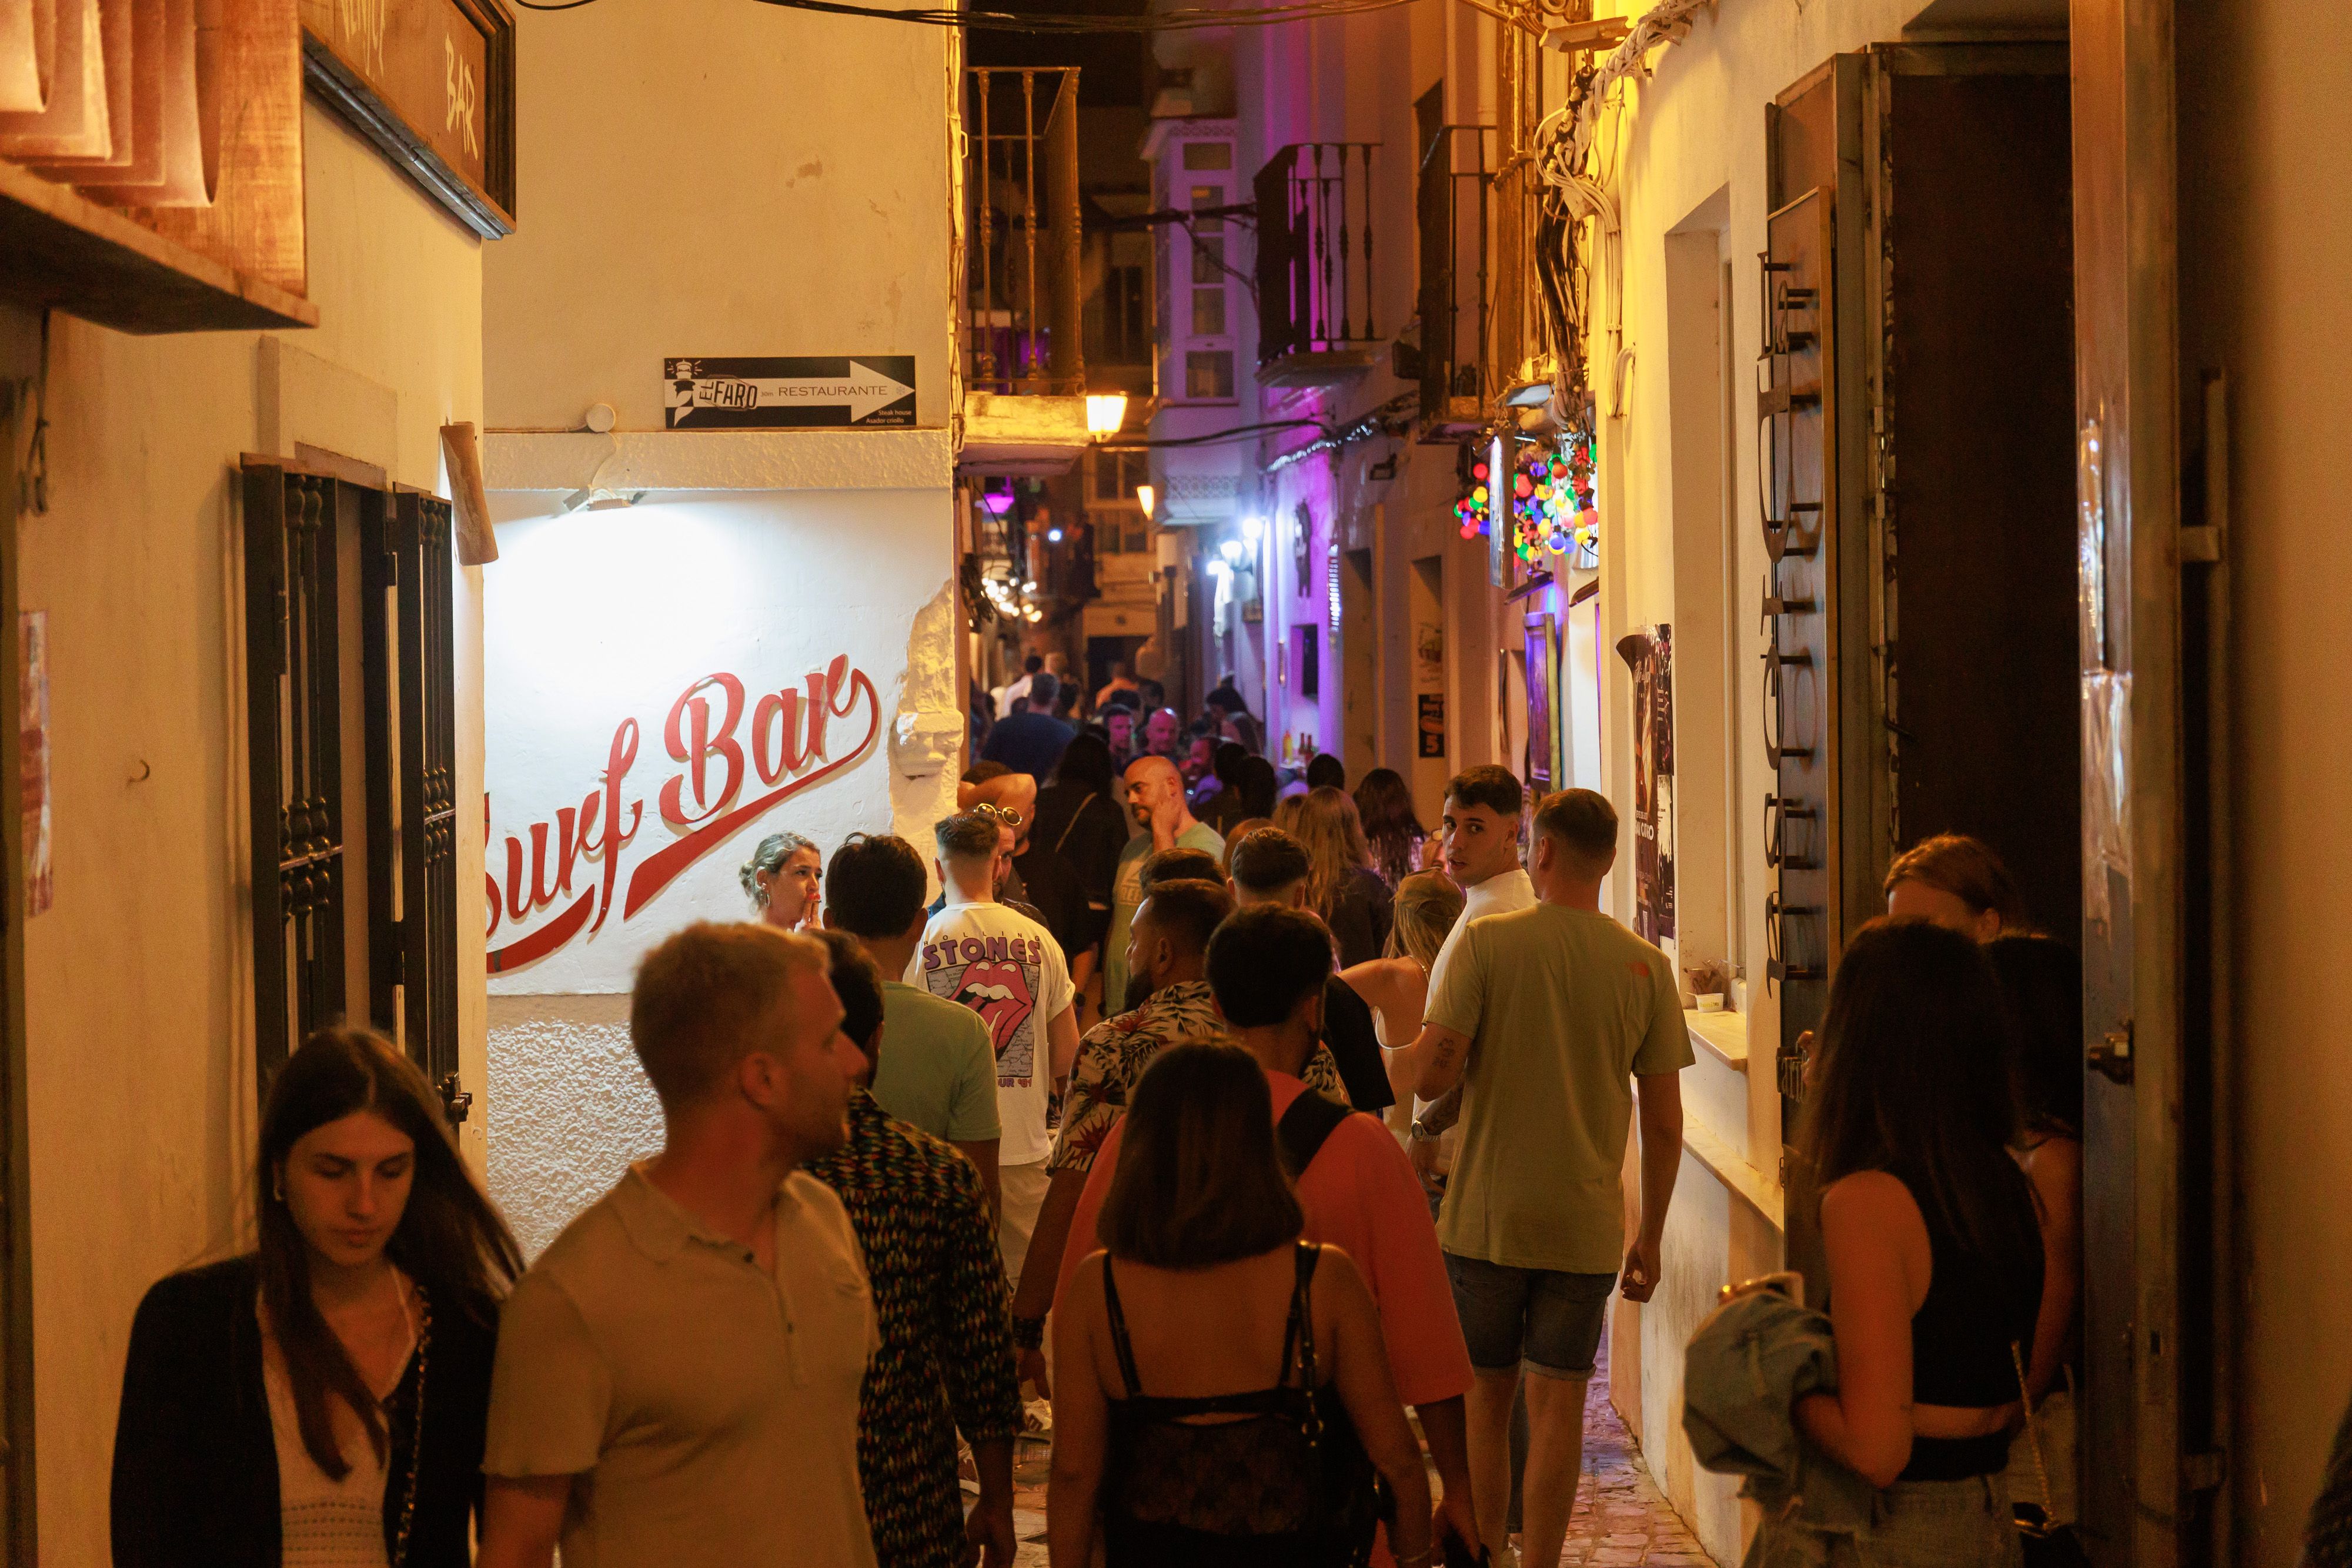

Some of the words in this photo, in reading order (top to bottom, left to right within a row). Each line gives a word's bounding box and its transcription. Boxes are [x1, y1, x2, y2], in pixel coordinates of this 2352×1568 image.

[445, 32, 478, 161] BAR
[699, 381, 714, 400] EL
[714, 380, 757, 409] FARO
[779, 385, 887, 397] RESTAURANTE
[659, 654, 878, 824] Bar
[923, 931, 1040, 945] ROLLING
[923, 937, 1041, 969] STONES
